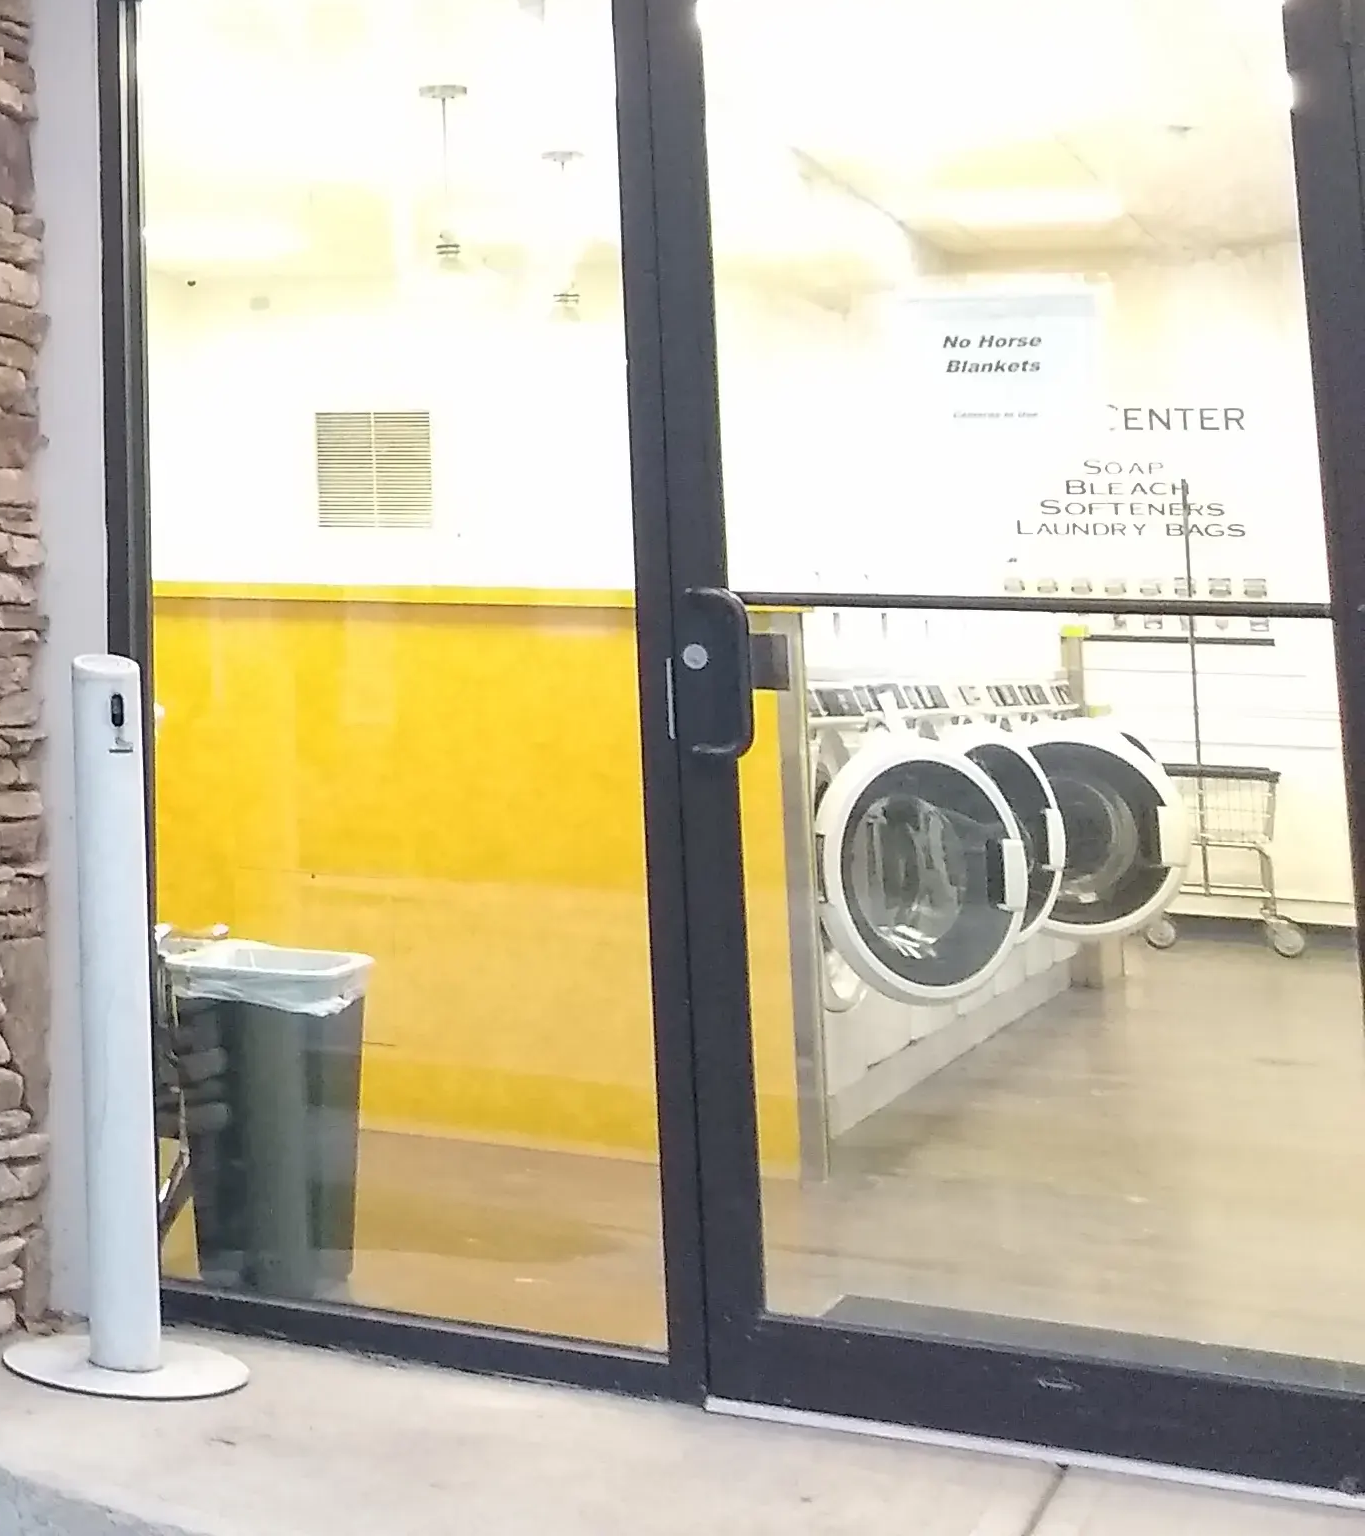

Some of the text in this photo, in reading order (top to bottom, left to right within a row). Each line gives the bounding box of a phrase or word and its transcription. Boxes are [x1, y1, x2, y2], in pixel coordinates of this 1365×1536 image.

[942, 334, 1042, 349] No Horse
[945, 359, 1041, 374] Blankets
[1107, 404, 1245, 431] ENTER
